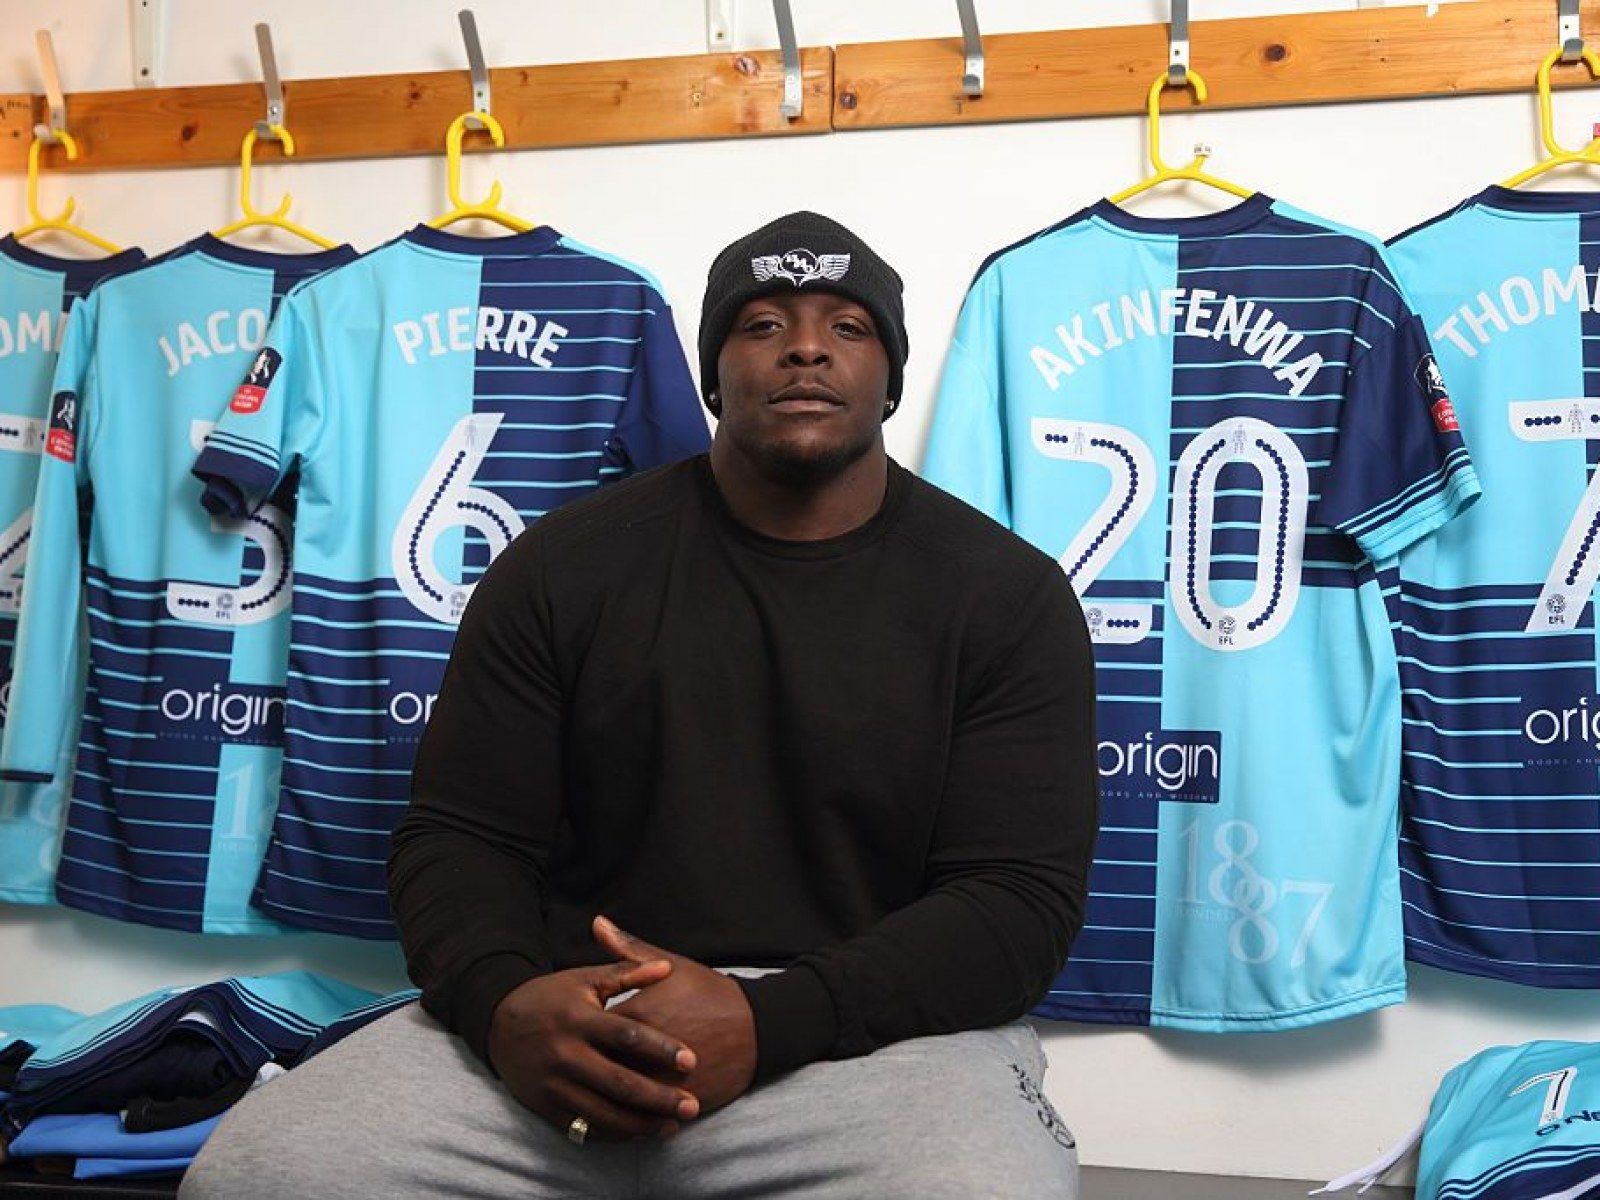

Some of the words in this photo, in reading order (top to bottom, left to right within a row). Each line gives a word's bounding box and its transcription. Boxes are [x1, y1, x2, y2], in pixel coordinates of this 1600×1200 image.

[393, 306, 568, 369] PIERRE
[1434, 264, 1600, 358] THOM
[1030, 288, 1324, 398] AKINFENWA
[391, 412, 526, 624] 6
[1031, 416, 1309, 651] 20
[1218, 636, 1233, 645] EFL
[1549, 615, 1565, 624] EFL
[162, 683, 286, 735] origin
[1525, 696, 1600, 751] ori
[1097, 731, 1217, 791] origin
